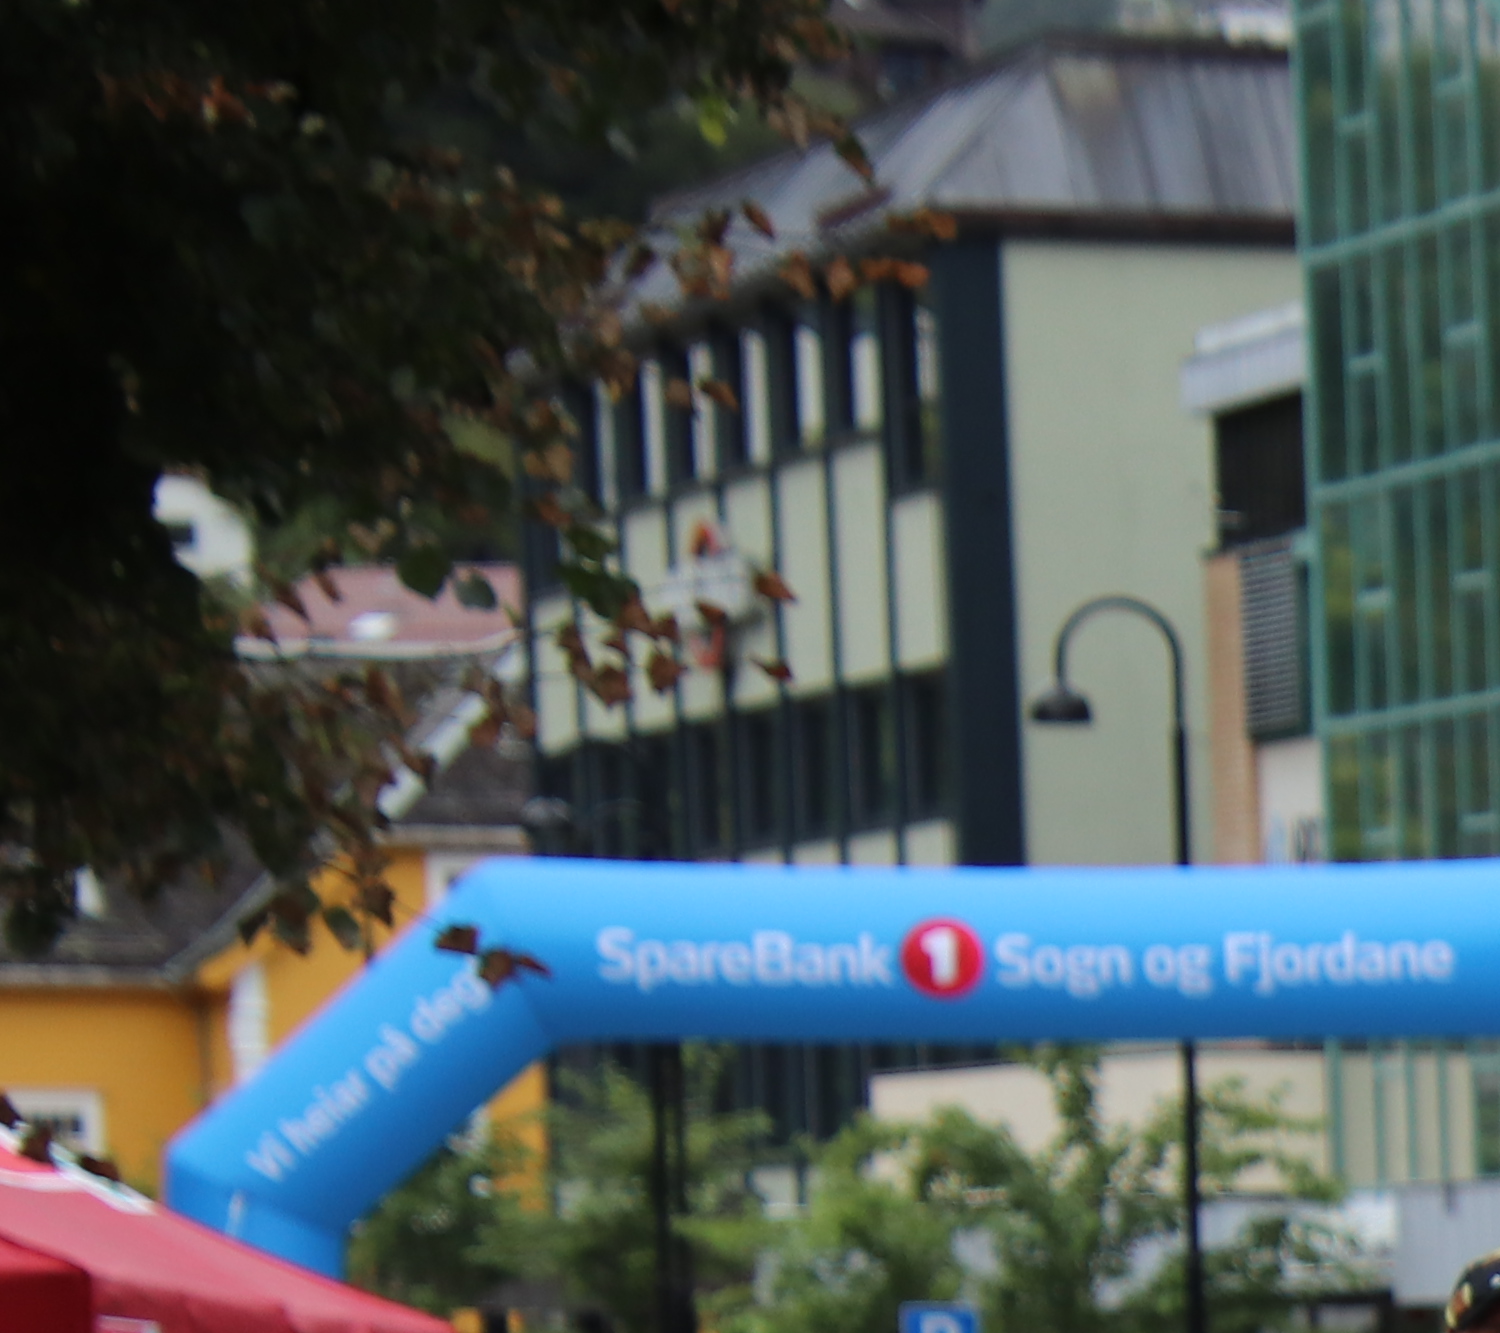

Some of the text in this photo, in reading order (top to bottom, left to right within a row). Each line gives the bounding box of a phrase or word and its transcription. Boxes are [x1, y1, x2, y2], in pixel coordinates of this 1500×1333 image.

[596, 926, 893, 993] SpareBank
[995, 931, 1133, 998] Sogn
[1143, 944, 1212, 997] og
[1224, 929, 1457, 995] Fjordane
